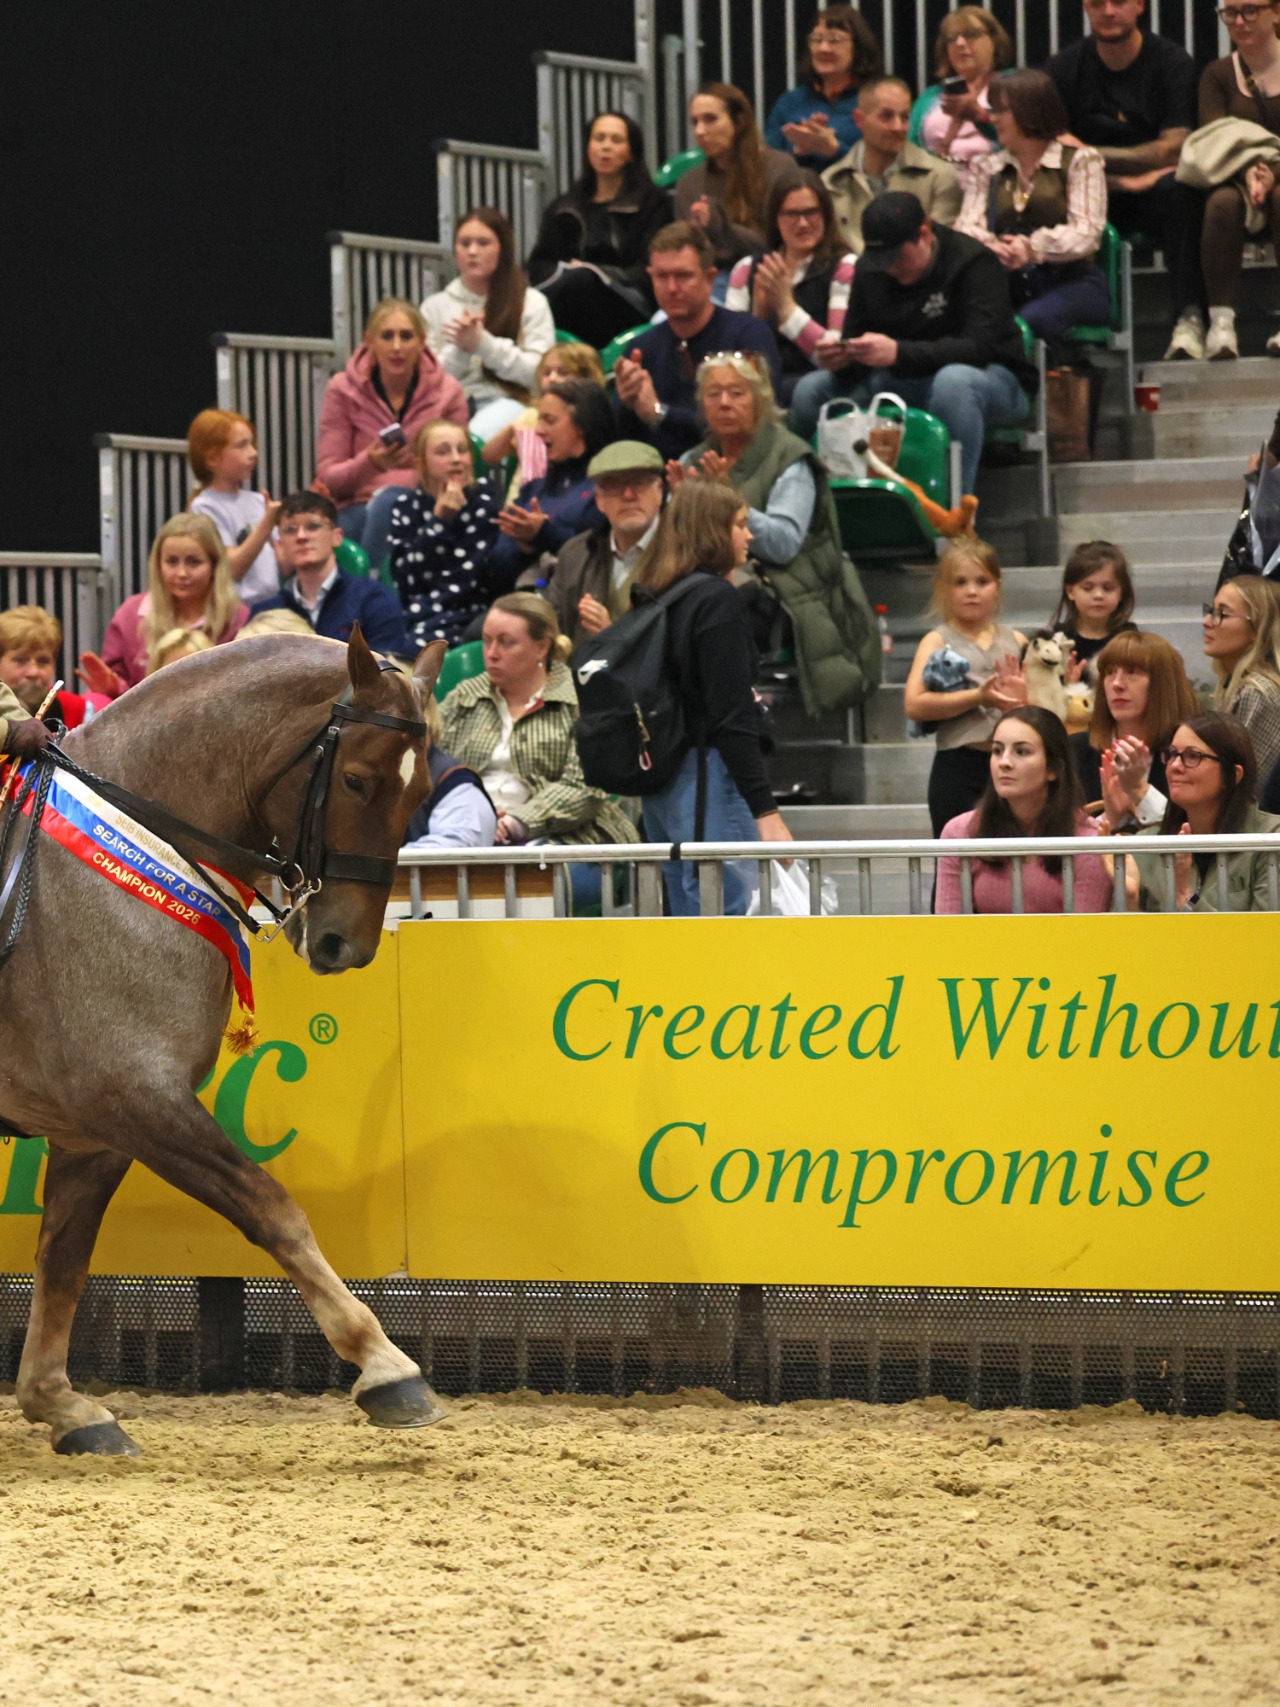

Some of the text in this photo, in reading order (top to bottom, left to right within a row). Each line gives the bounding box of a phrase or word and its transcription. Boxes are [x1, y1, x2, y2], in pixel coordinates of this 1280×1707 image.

[93, 824, 146, 866] SEARCH
[145, 862, 176, 886] FOR
[175, 882, 187, 894] A
[187, 890, 221, 916] STAR
[115, 815, 180, 870] SEIB INSURANCE
[92, 852, 167, 904] CHAMPION
[166, 900, 201, 925] 2026
[553, 975, 905, 1060] Created
[639, 1121, 1210, 1228] Compromise
